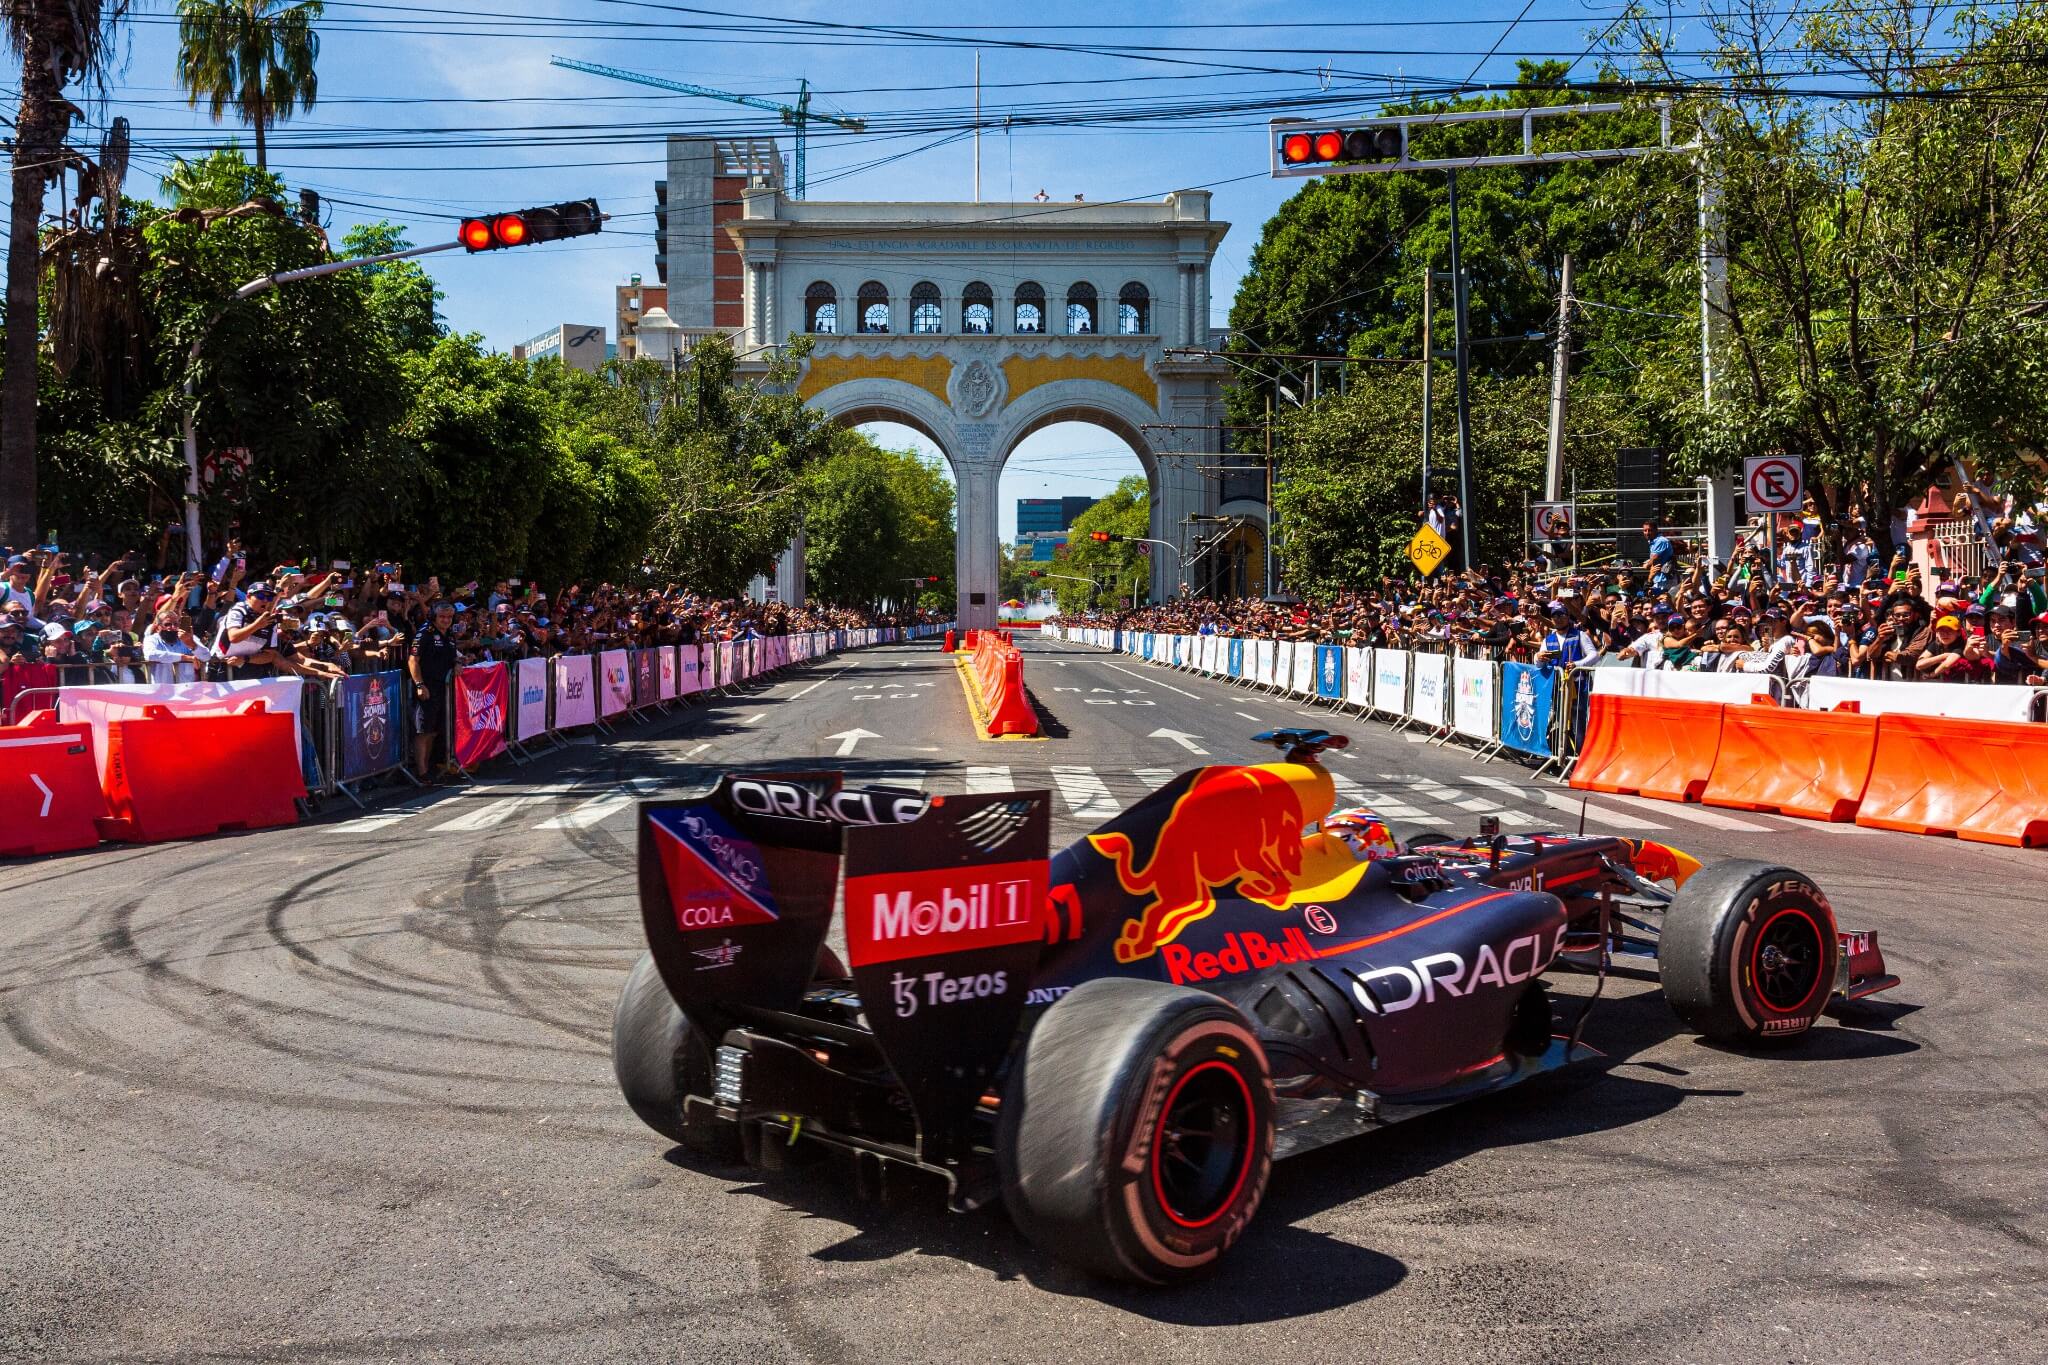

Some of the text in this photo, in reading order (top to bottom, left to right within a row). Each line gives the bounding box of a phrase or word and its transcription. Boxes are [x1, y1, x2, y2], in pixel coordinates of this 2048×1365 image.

[917, 240, 978, 250] AGRADABLE
[1066, 240, 1080, 250] DE
[1087, 240, 1135, 250] REGRESO
[682, 906, 735, 927] COLA
[872, 883, 1018, 942] Mobil 1
[1162, 927, 1318, 986] Red Bull
[923, 970, 1009, 1006] Tezos
